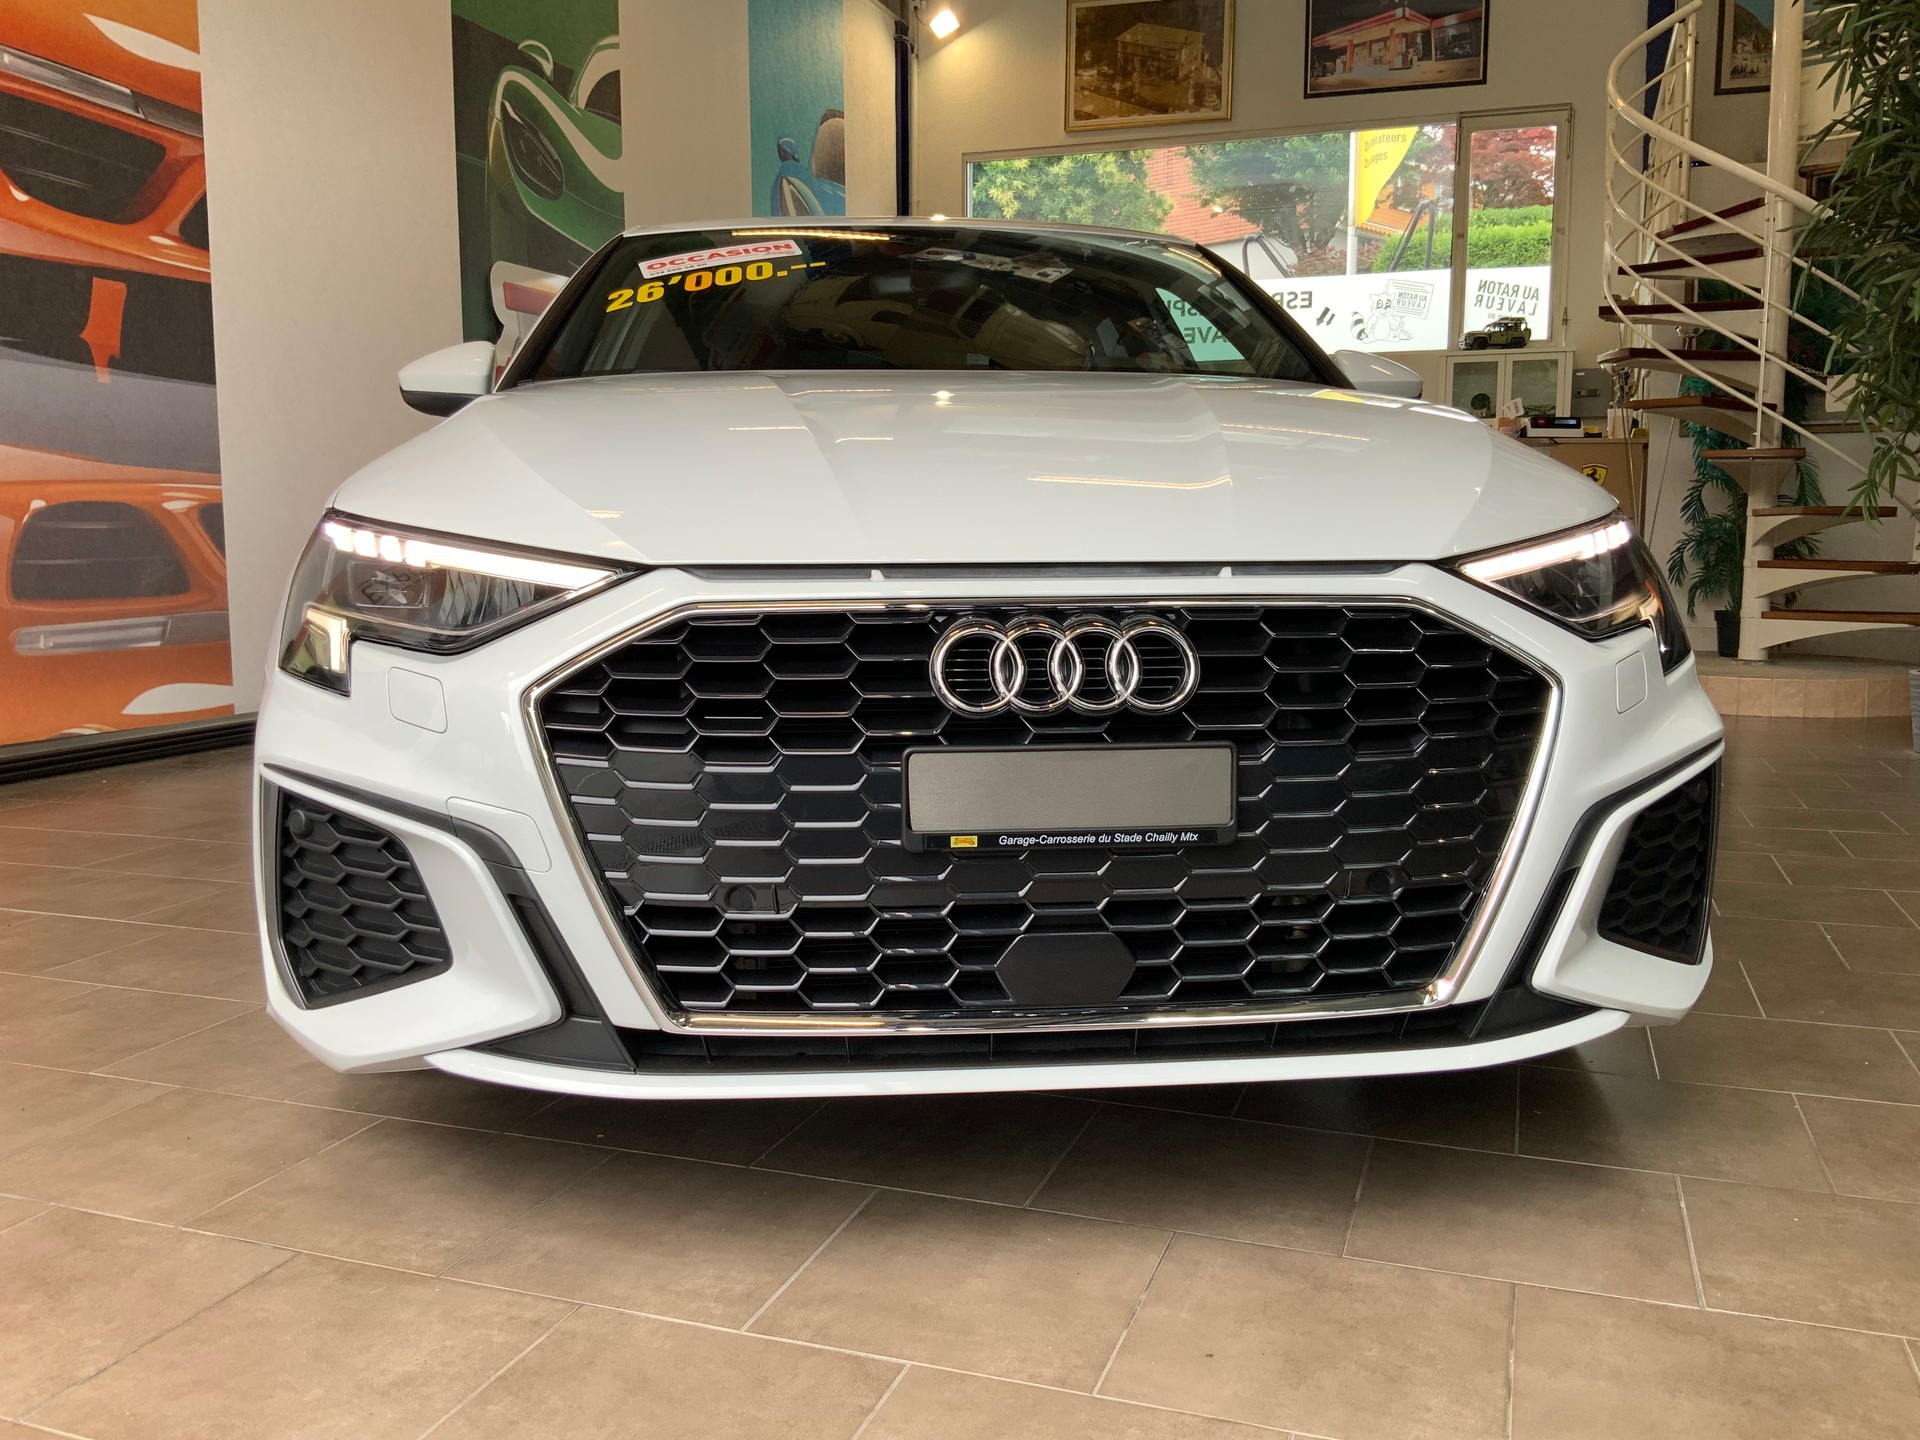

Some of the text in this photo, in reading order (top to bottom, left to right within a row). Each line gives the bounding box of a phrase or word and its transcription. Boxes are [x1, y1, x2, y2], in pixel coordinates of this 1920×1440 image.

[646, 243, 793, 271] OCCASION
[998, 831, 1199, 847] Garage-Carrosserie du Stade Chailly Mtx
